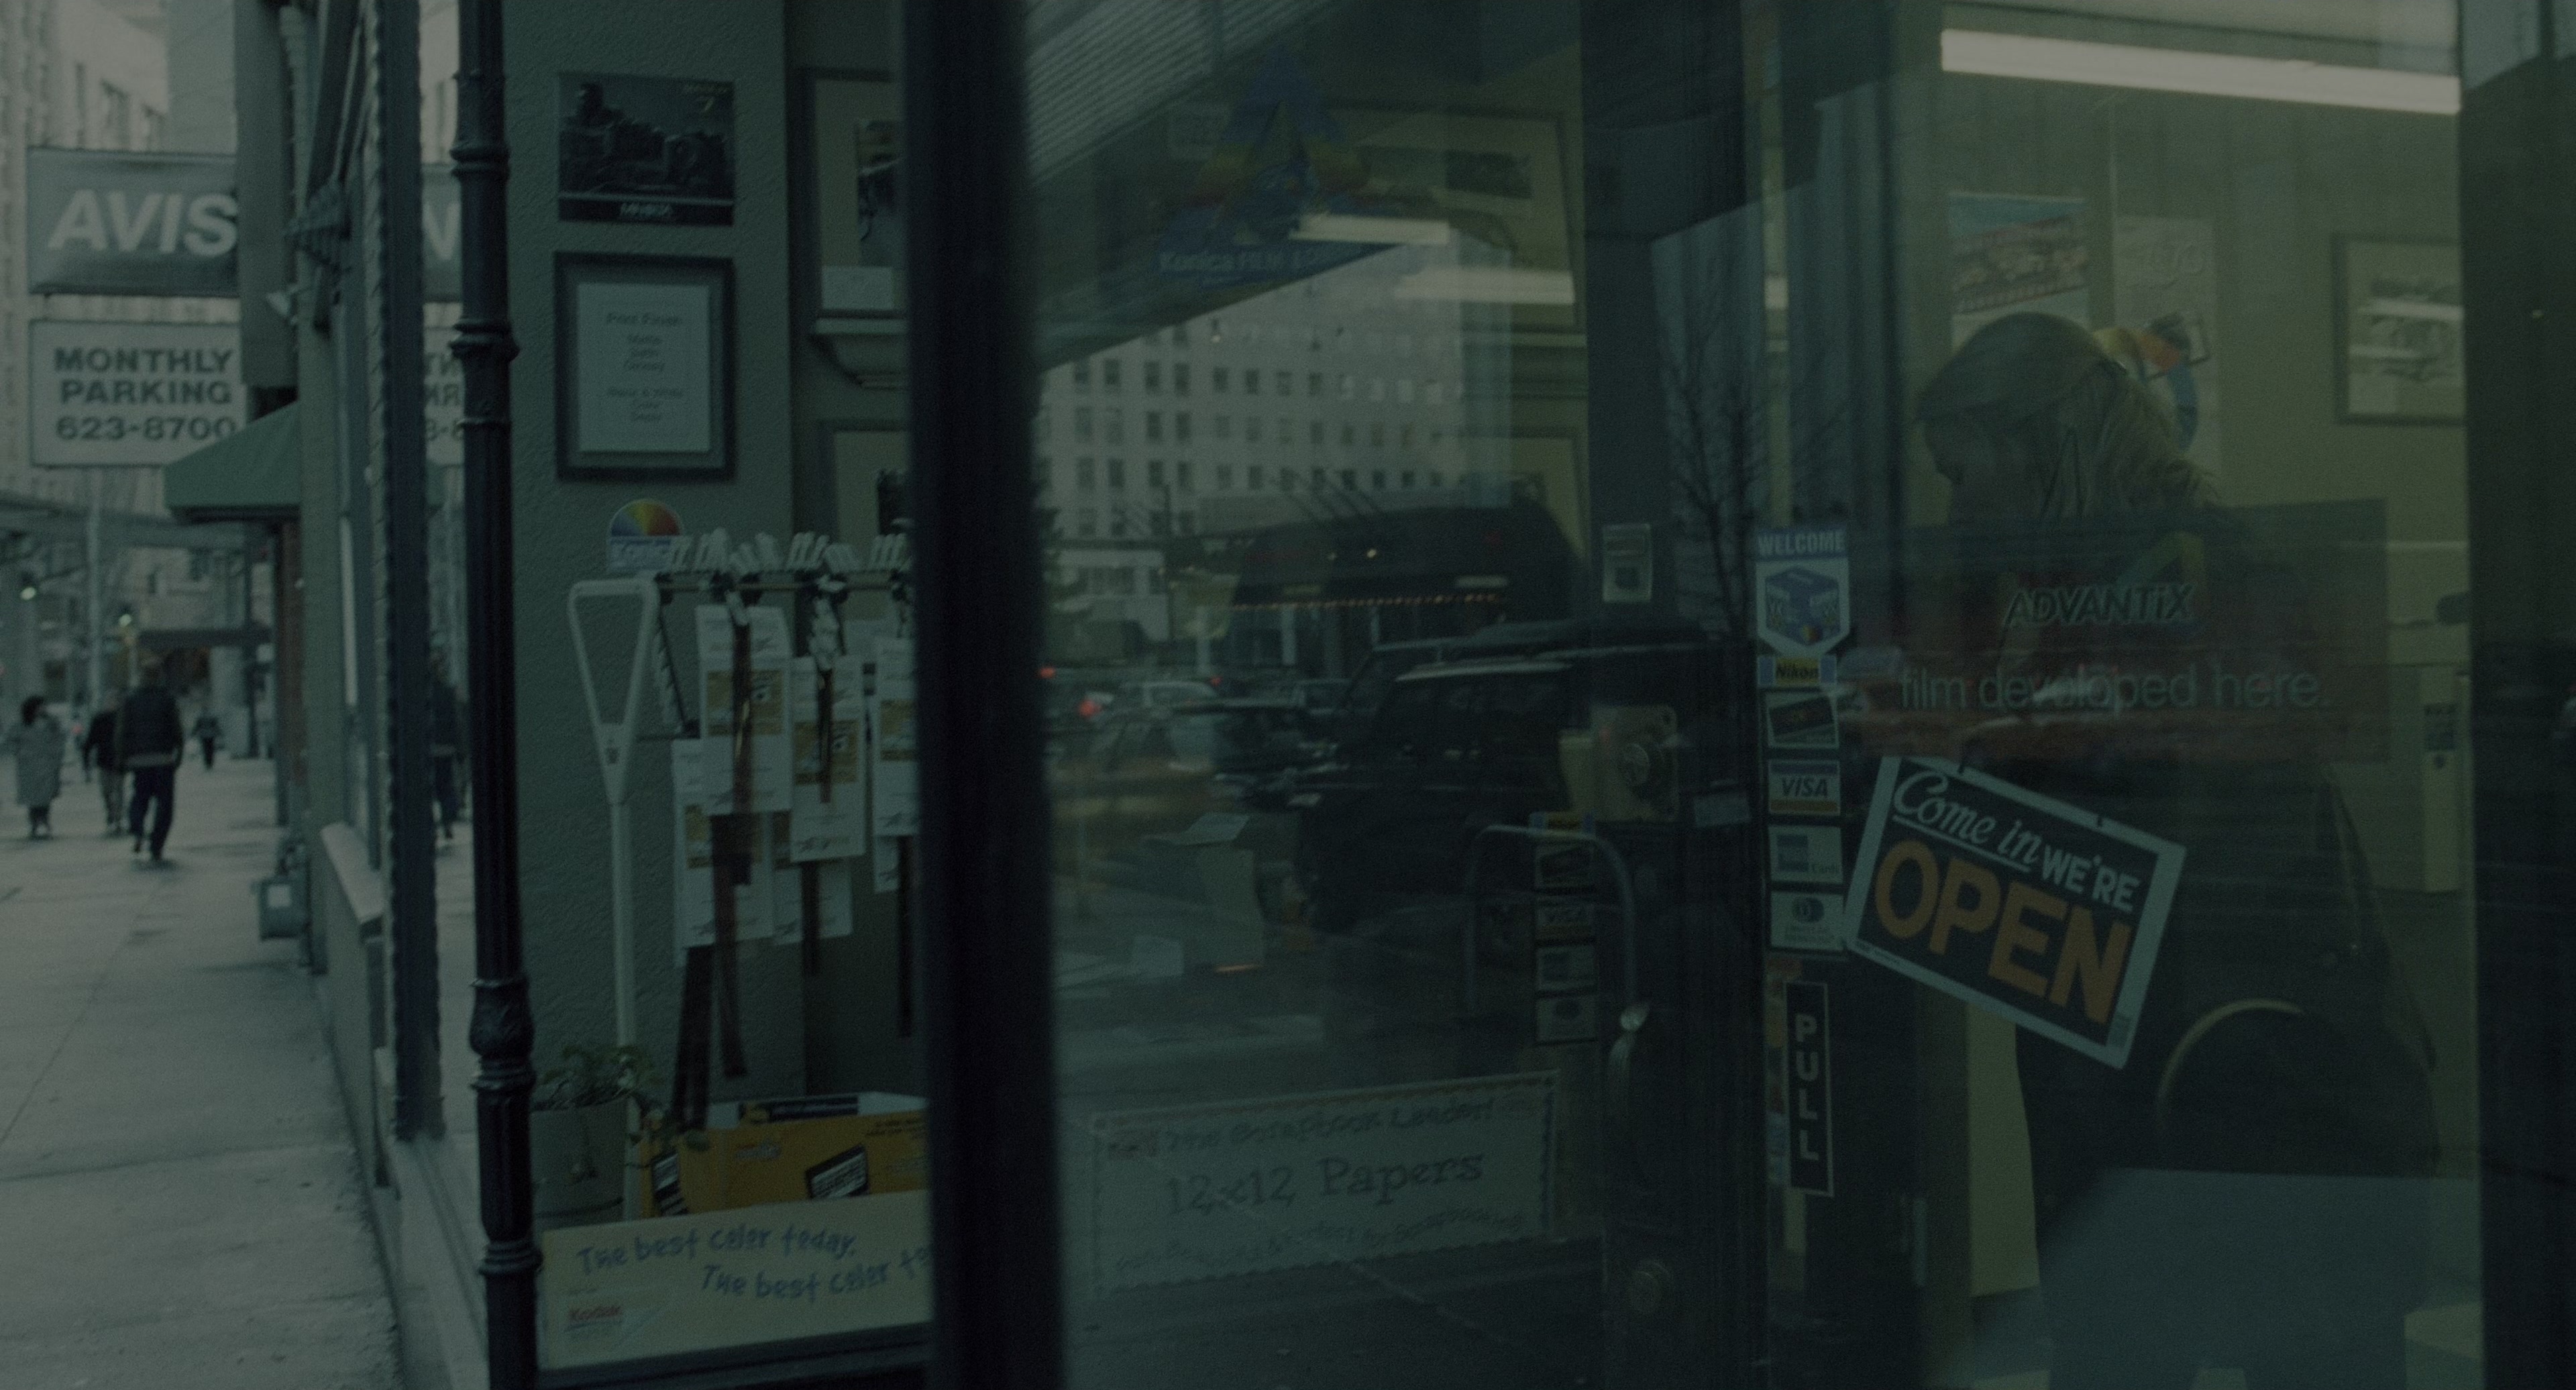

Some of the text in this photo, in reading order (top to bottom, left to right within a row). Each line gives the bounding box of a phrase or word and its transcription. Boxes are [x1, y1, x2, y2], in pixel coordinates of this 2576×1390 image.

[47, 189, 238, 257] AVIS
[54, 346, 233, 373] MONTHLY
[60, 380, 233, 405] PARKING
[55, 415, 237, 441] 623-8700
[1758, 529, 1845, 556] WELCOME
[1775, 661, 1819, 680] Nikon
[1898, 664, 2331, 718] film developed here.
[1781, 776, 1829, 798] VISA
[1893, 771, 2142, 914] Come in WE'RE
[1874, 840, 2132, 1025] OPEN
[1794, 1012, 1820, 1161] PULL
[1166, 1153, 1485, 1216] 12x12 Papers
[576, 1222, 857, 1277] The best color today.
[700, 1264, 747, 1297] The
[755, 1271, 821, 1303] best
[828, 1262, 891, 1294] color
